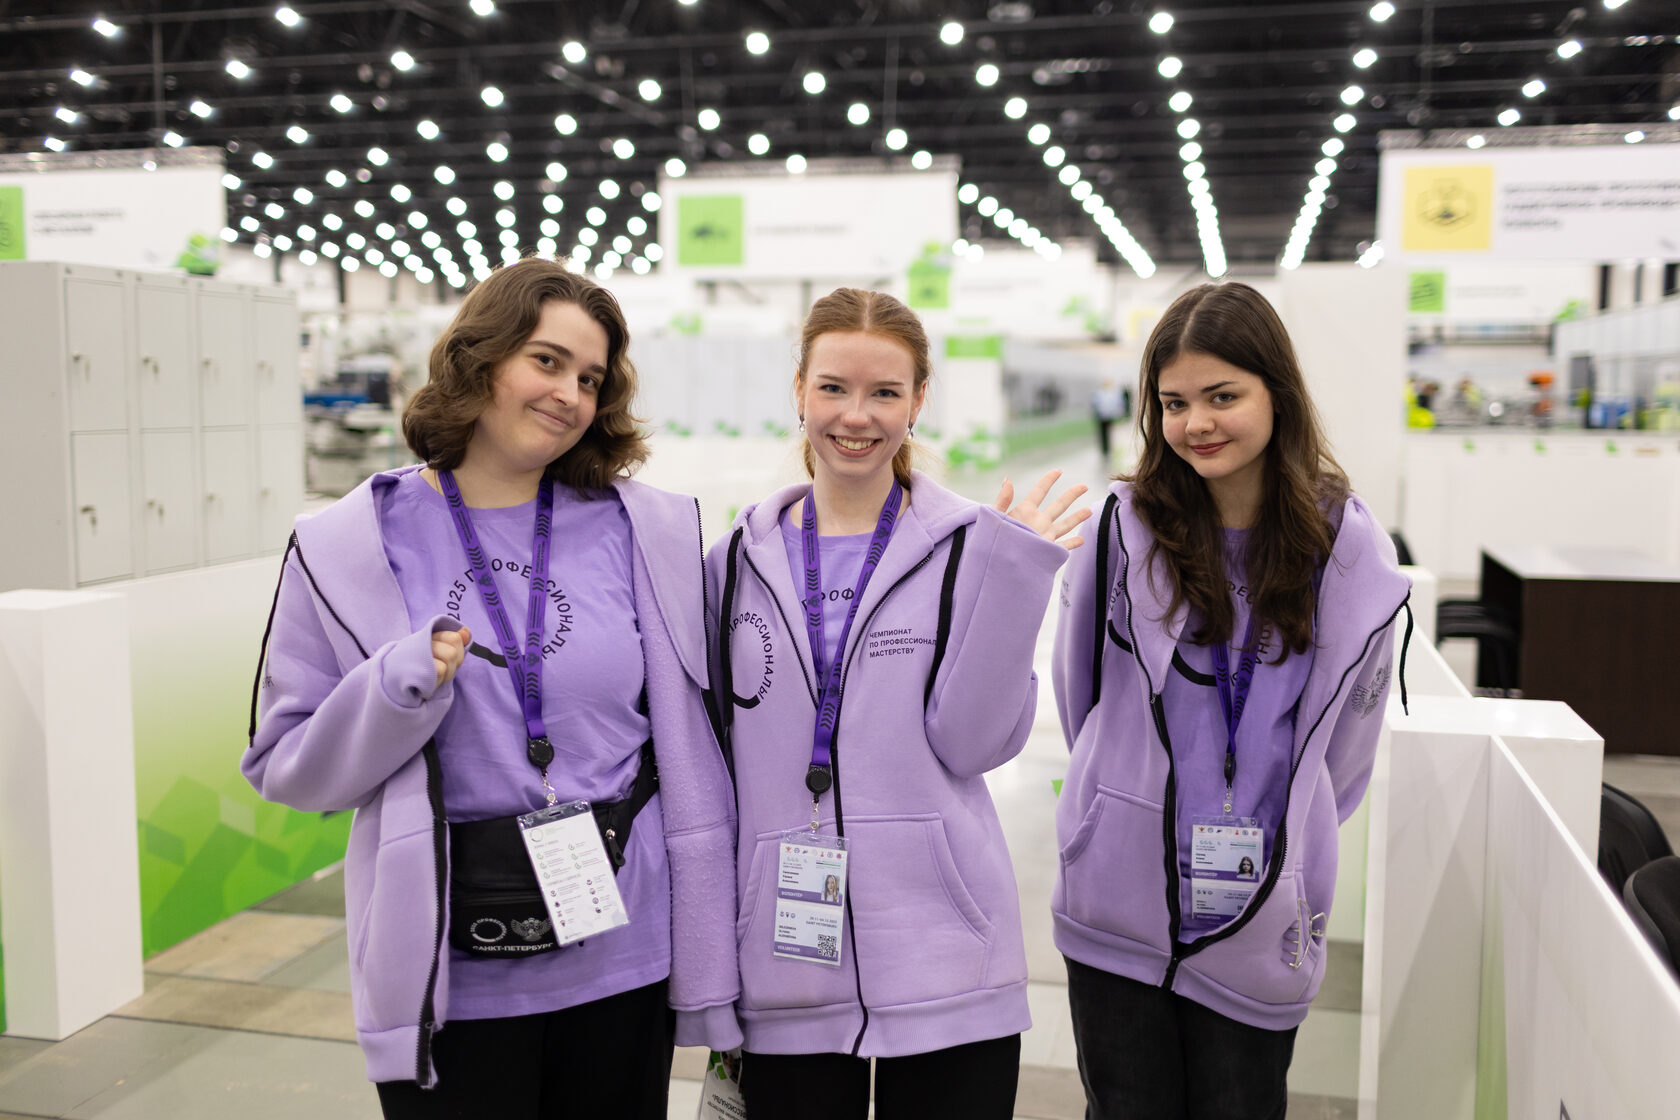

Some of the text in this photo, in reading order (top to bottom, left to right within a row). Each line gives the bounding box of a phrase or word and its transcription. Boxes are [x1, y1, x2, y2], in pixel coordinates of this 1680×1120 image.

[464, 558, 574, 660] ПОФЕСИОНАЛЫ
[869, 628, 912, 639] ЧЕМПИОНАТ
[869, 647, 915, 658] МАСТЕРСТВУ
[472, 942, 554, 952] САНКТ-ПЕТЕРБУРГ
